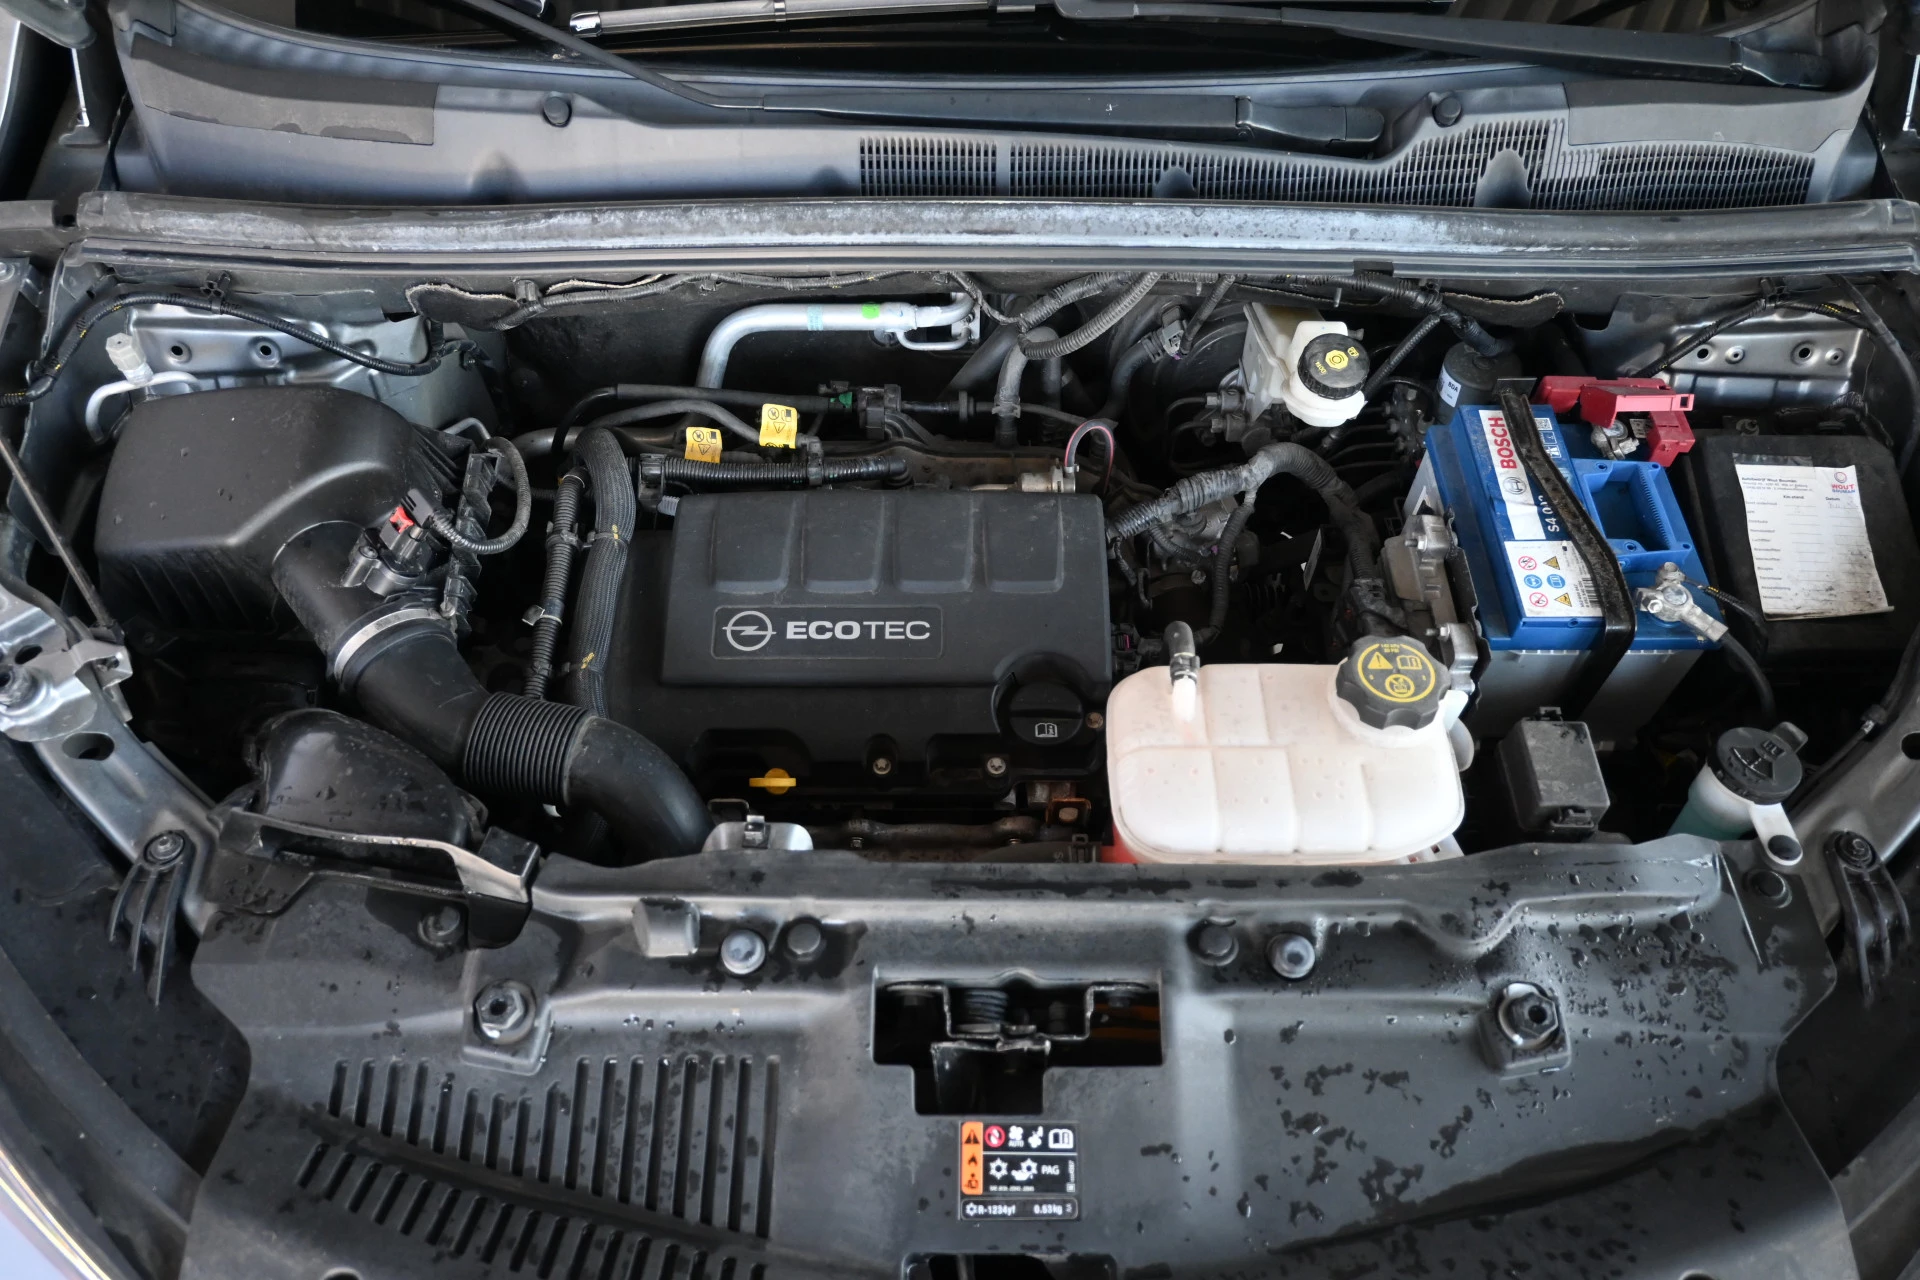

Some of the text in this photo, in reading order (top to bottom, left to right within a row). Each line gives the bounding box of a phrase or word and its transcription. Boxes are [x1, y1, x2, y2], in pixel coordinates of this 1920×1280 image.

[1488, 417, 1517, 469] BOSCH
[786, 620, 931, 640] ECOTEC
[1041, 1165, 1060, 1175] PAG
[977, 1204, 1016, 1216] R-1234yf
